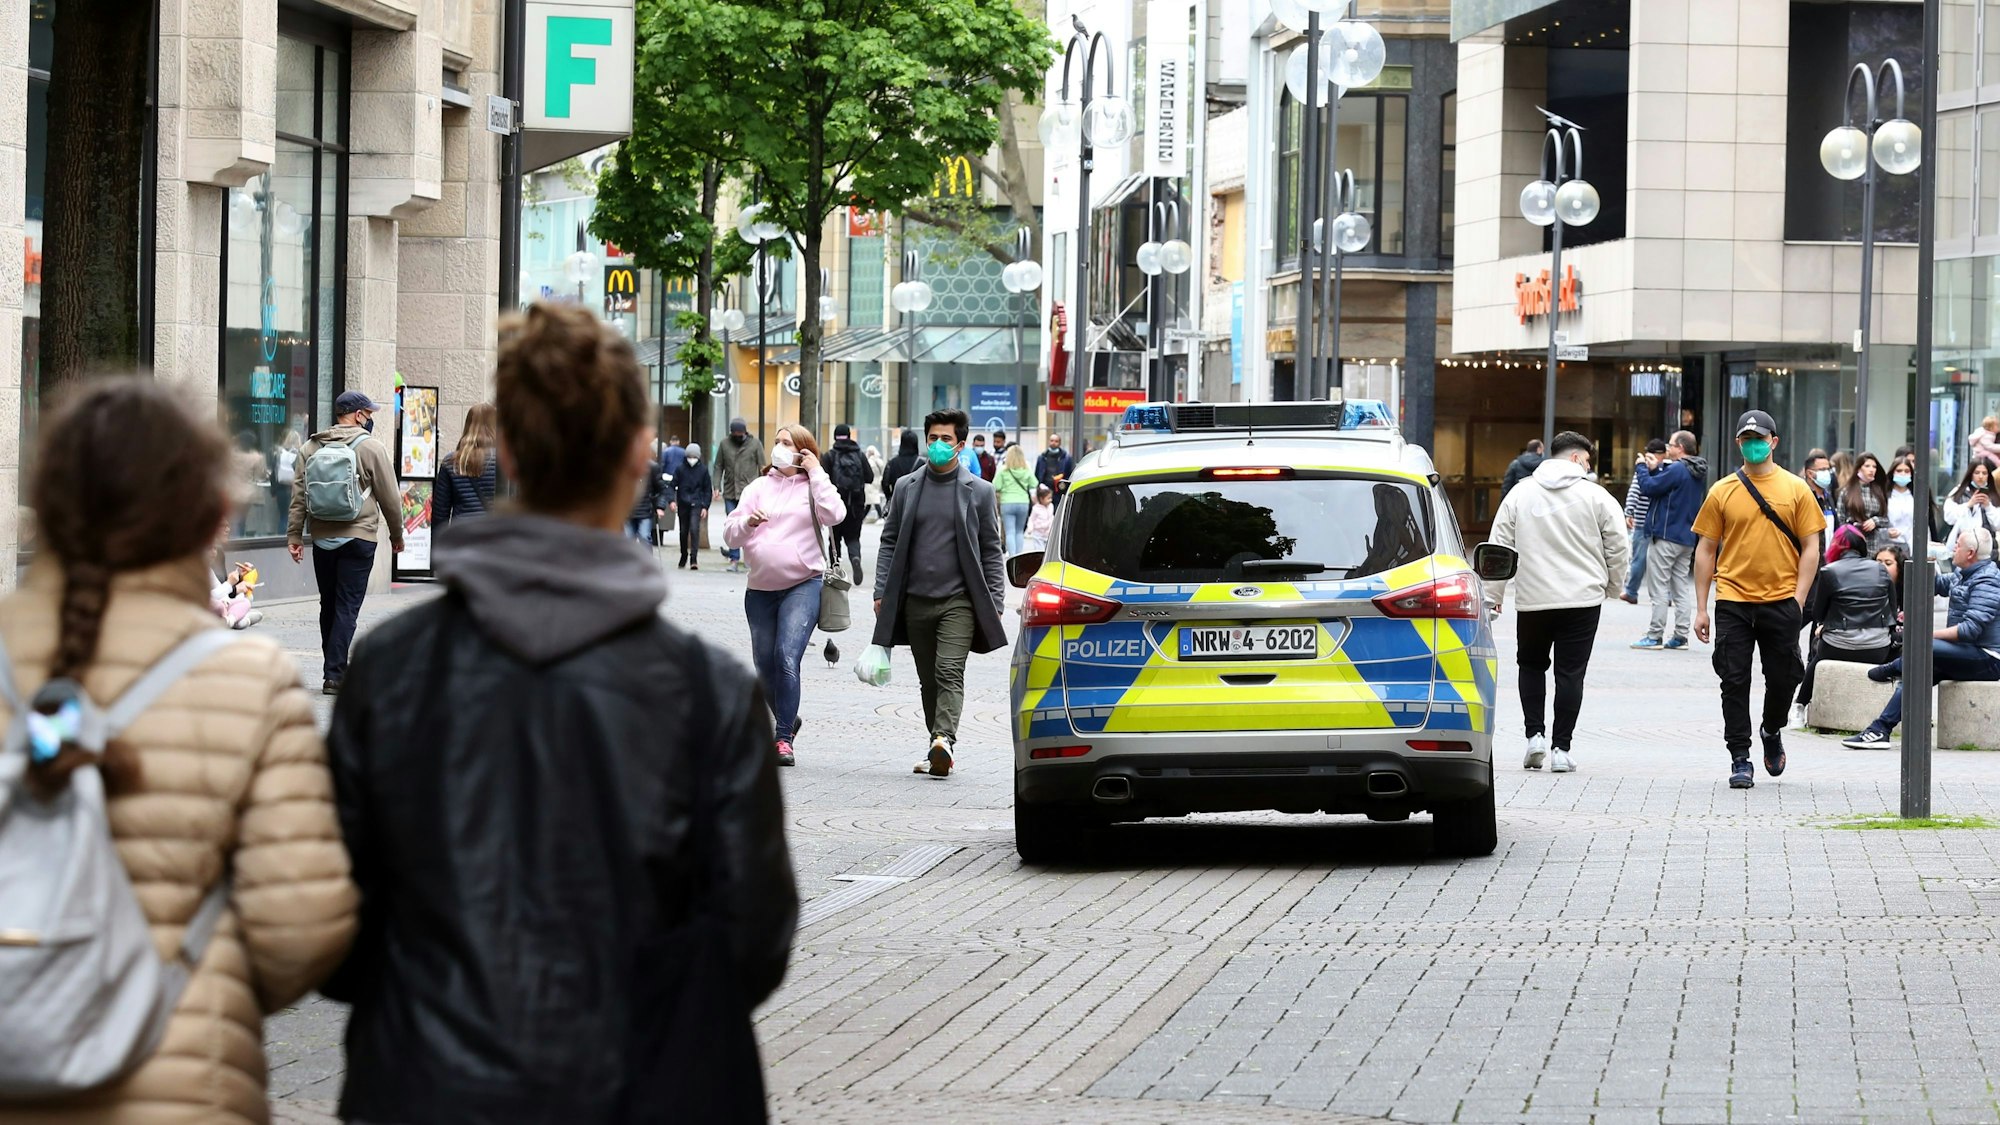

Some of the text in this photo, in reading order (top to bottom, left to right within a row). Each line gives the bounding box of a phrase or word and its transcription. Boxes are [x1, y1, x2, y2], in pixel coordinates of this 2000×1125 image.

[544, 16, 612, 118] F
[1159, 61, 1176, 161] WAM DENIM
[1084, 396, 1110, 408] rische
[1066, 639, 1146, 659] POLIZEI
[1192, 629, 1315, 652] NRW 4-6202
